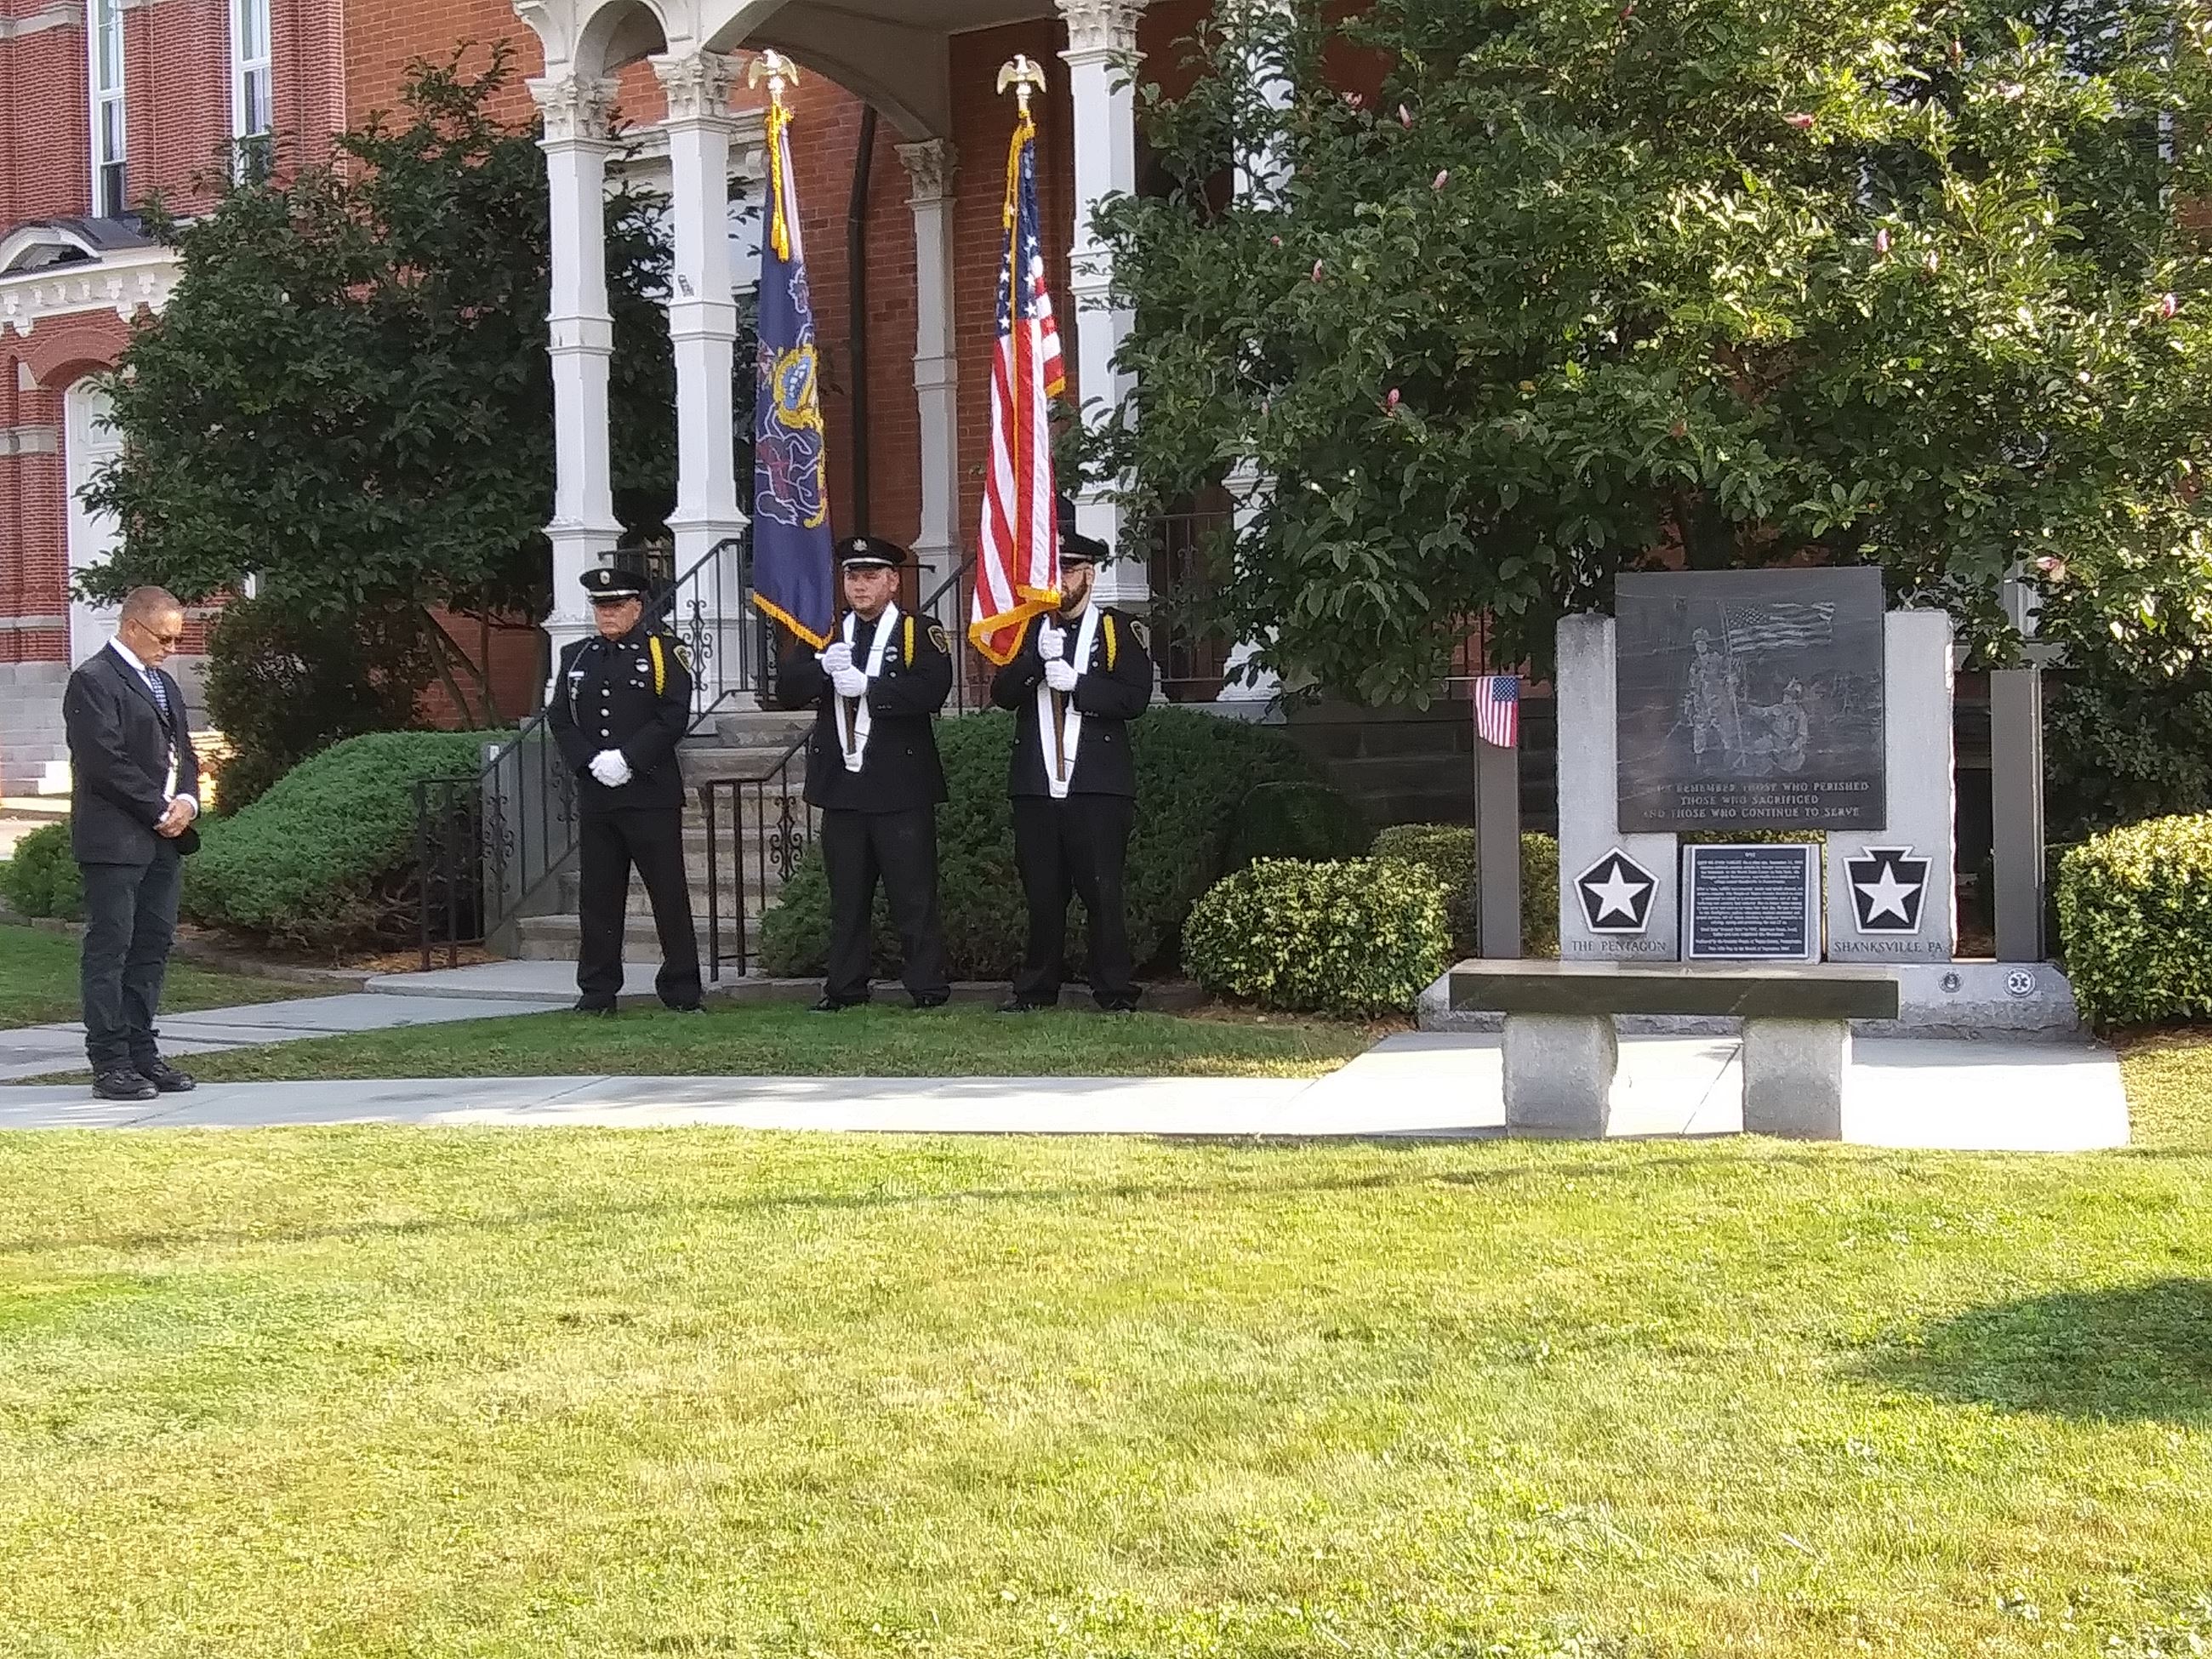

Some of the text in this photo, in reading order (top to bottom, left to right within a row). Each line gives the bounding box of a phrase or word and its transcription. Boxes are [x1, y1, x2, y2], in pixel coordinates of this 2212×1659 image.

[1676, 783, 1735, 793] REMEMBER
[1782, 782, 1809, 791] WHO
[1813, 782, 1870, 791] PERISHED
[1680, 796, 1716, 806] THOSE
[1751, 795, 1819, 805] SACRIFICED
[1671, 808, 1706, 818] THOSE
[1710, 807, 1736, 818] WHO
[1741, 807, 1799, 818] CONTINUE
[1804, 807, 1819, 817] TO
[1824, 807, 1859, 818] SERVE
[1571, 940, 1667, 952] THE PENTAGON
[1834, 940, 1942, 953] SHANKSVILLE PA
